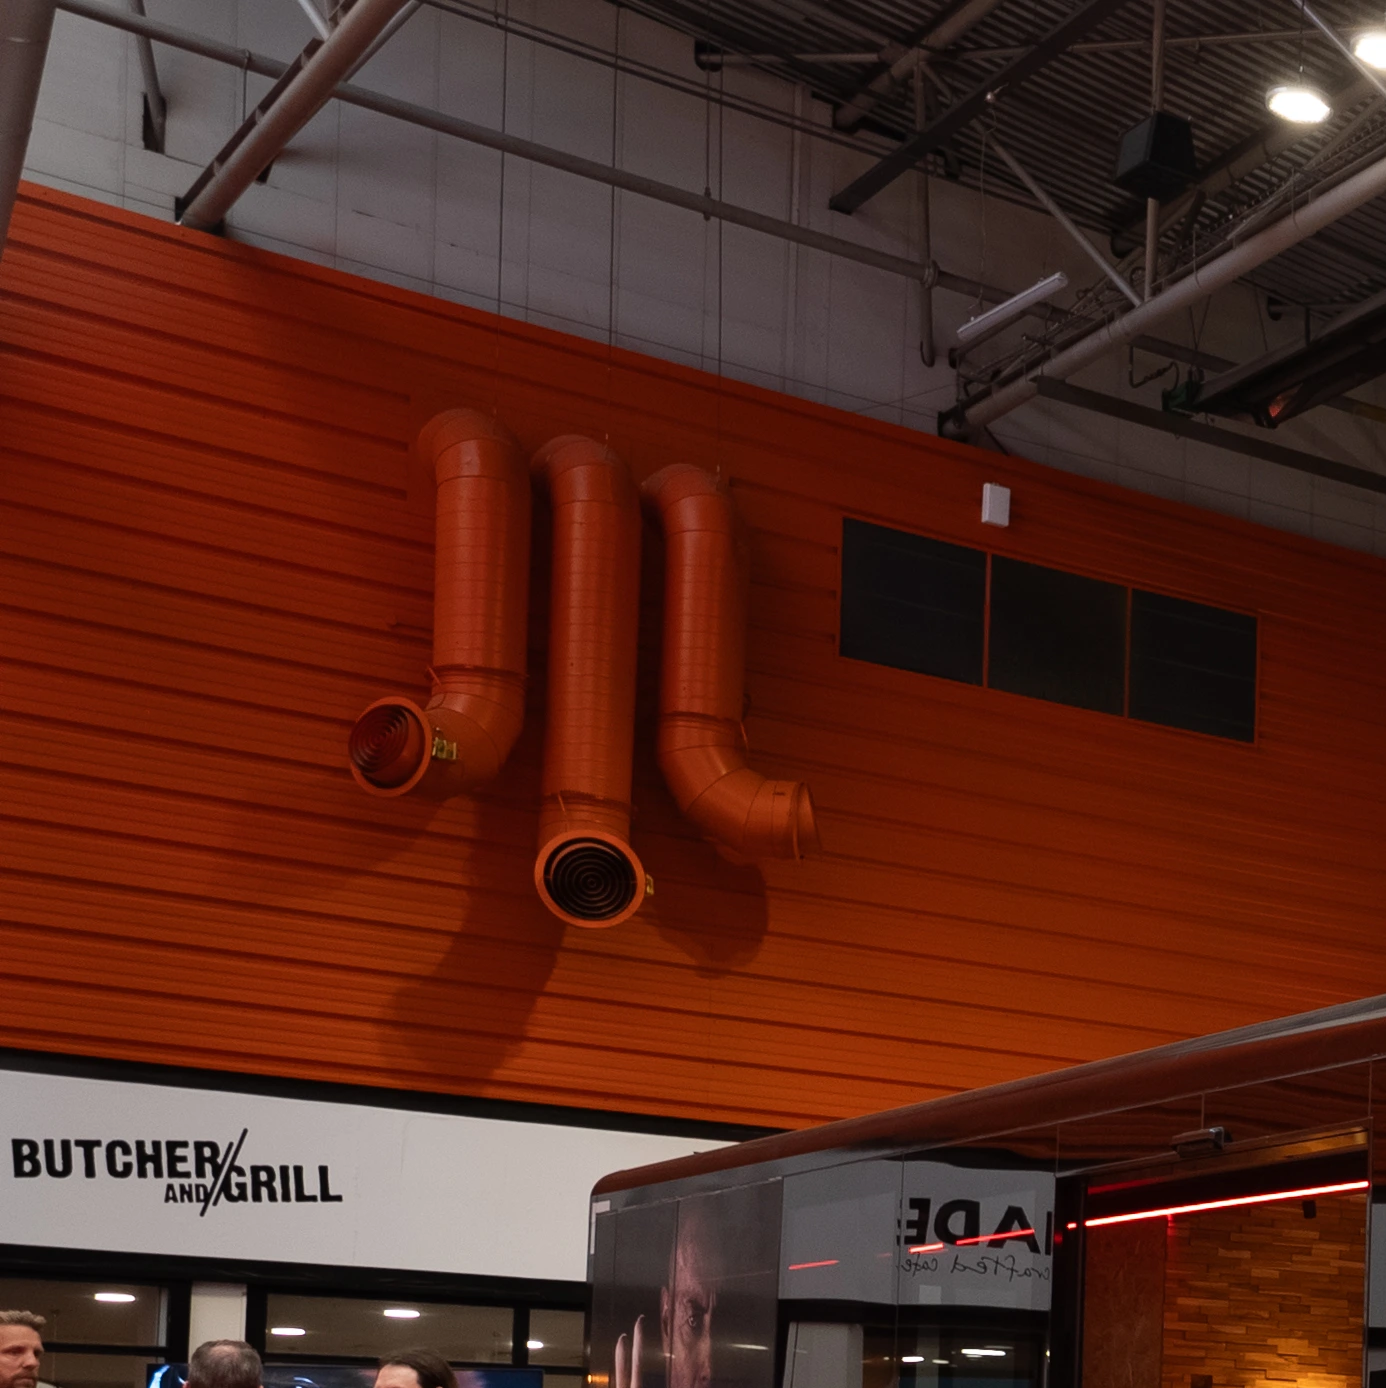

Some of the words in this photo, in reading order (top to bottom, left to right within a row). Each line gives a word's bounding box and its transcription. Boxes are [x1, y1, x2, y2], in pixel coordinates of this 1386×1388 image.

[11, 1138, 222, 1179] BUTCHER
[163, 1183, 210, 1204] AND
[221, 1164, 344, 1204] GRILL
